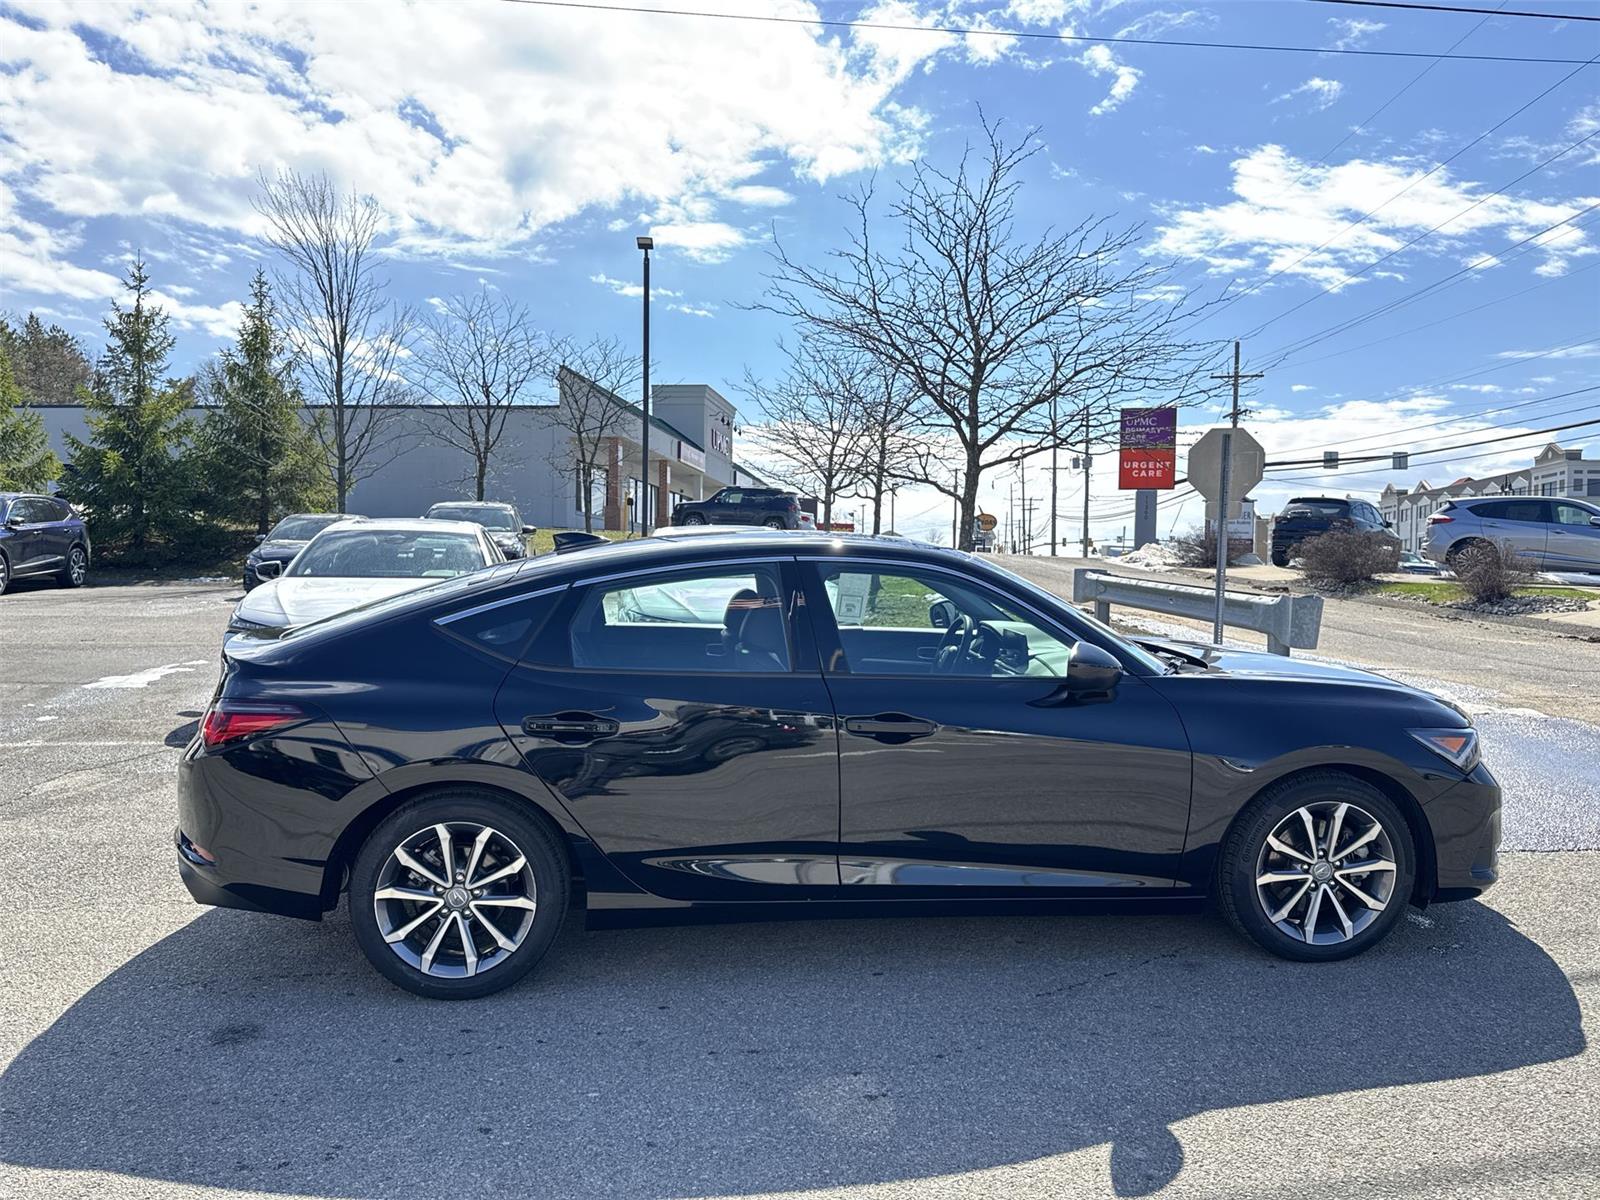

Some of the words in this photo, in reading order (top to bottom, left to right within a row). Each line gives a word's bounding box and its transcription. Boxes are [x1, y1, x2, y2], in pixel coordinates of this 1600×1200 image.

[1126, 417, 1157, 426] UPMC
[1123, 461, 1171, 469] URGENT
[1132, 469, 1163, 477] CARE
